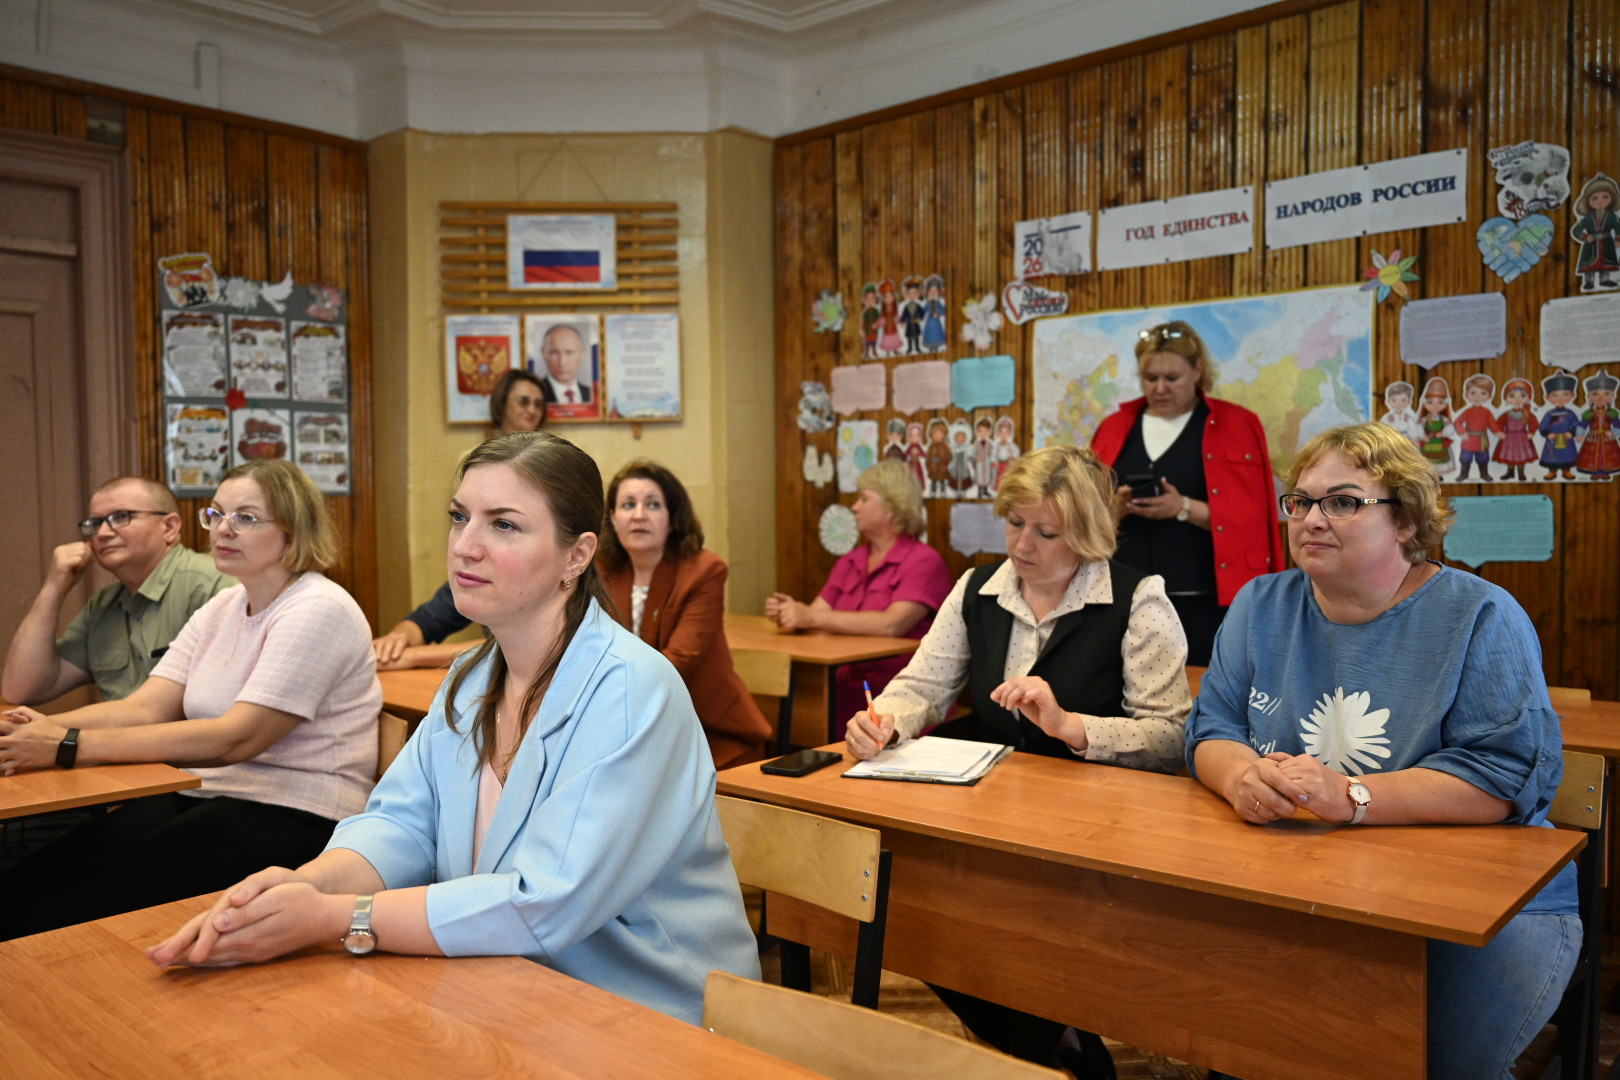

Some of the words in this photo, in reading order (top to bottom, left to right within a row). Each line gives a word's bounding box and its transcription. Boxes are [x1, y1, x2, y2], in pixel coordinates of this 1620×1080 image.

[1275, 191, 1362, 220] НАРОДОВ
[1372, 175, 1457, 203] РОССИИ
[1125, 225, 1155, 241] ГОД
[1163, 210, 1249, 237] ЕДИНСТВА
[1023, 238, 1043, 257] 20
[1023, 256, 1043, 274] 26
